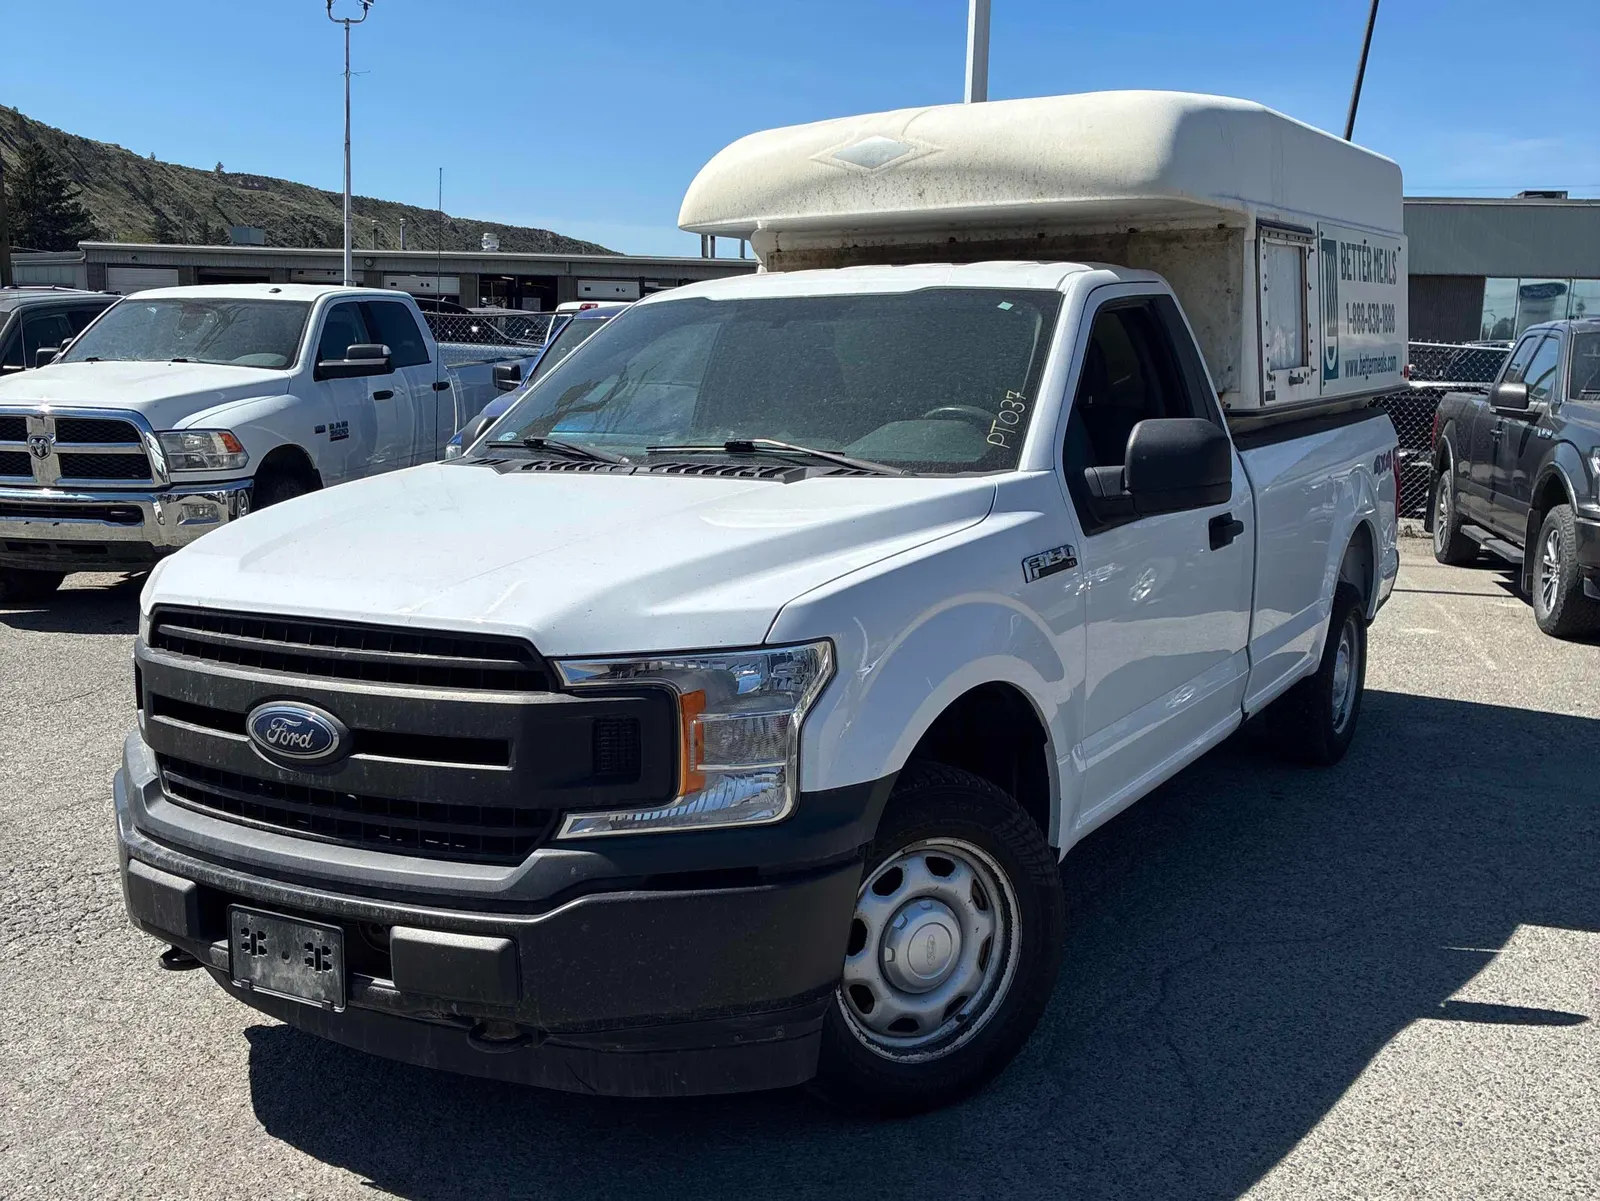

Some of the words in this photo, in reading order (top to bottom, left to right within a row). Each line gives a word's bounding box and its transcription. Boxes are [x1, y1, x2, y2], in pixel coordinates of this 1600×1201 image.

[1340, 241, 1372, 282] BETTER
[1373, 246, 1397, 285] MEALS
[1345, 302, 1396, 335] 1-888-838-1888
[1344, 352, 1397, 377] www.bettermeals.com
[986, 390, 1026, 449] PT037
[266, 717, 315, 749] Ford
